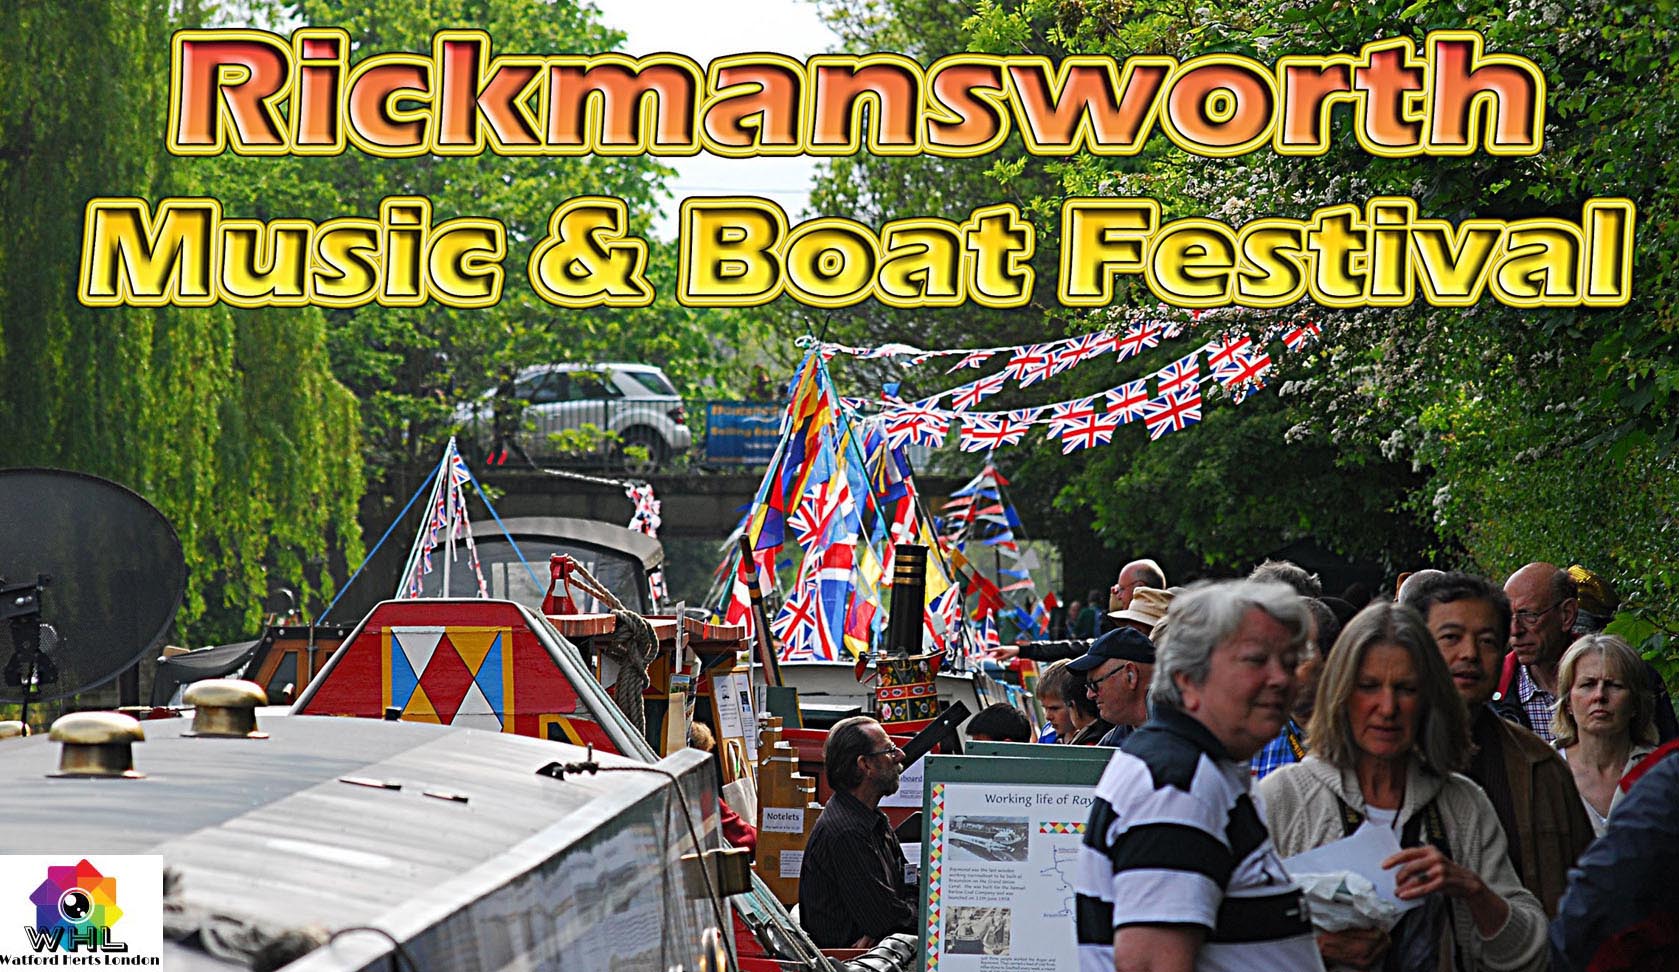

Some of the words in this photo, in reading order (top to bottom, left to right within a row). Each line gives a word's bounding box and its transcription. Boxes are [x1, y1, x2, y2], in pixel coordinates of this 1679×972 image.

[984, 793, 1032, 808] Working
[1036, 793, 1054, 805] life
[1056, 793, 1070, 805] of
[766, 811, 800, 821] Notelets
